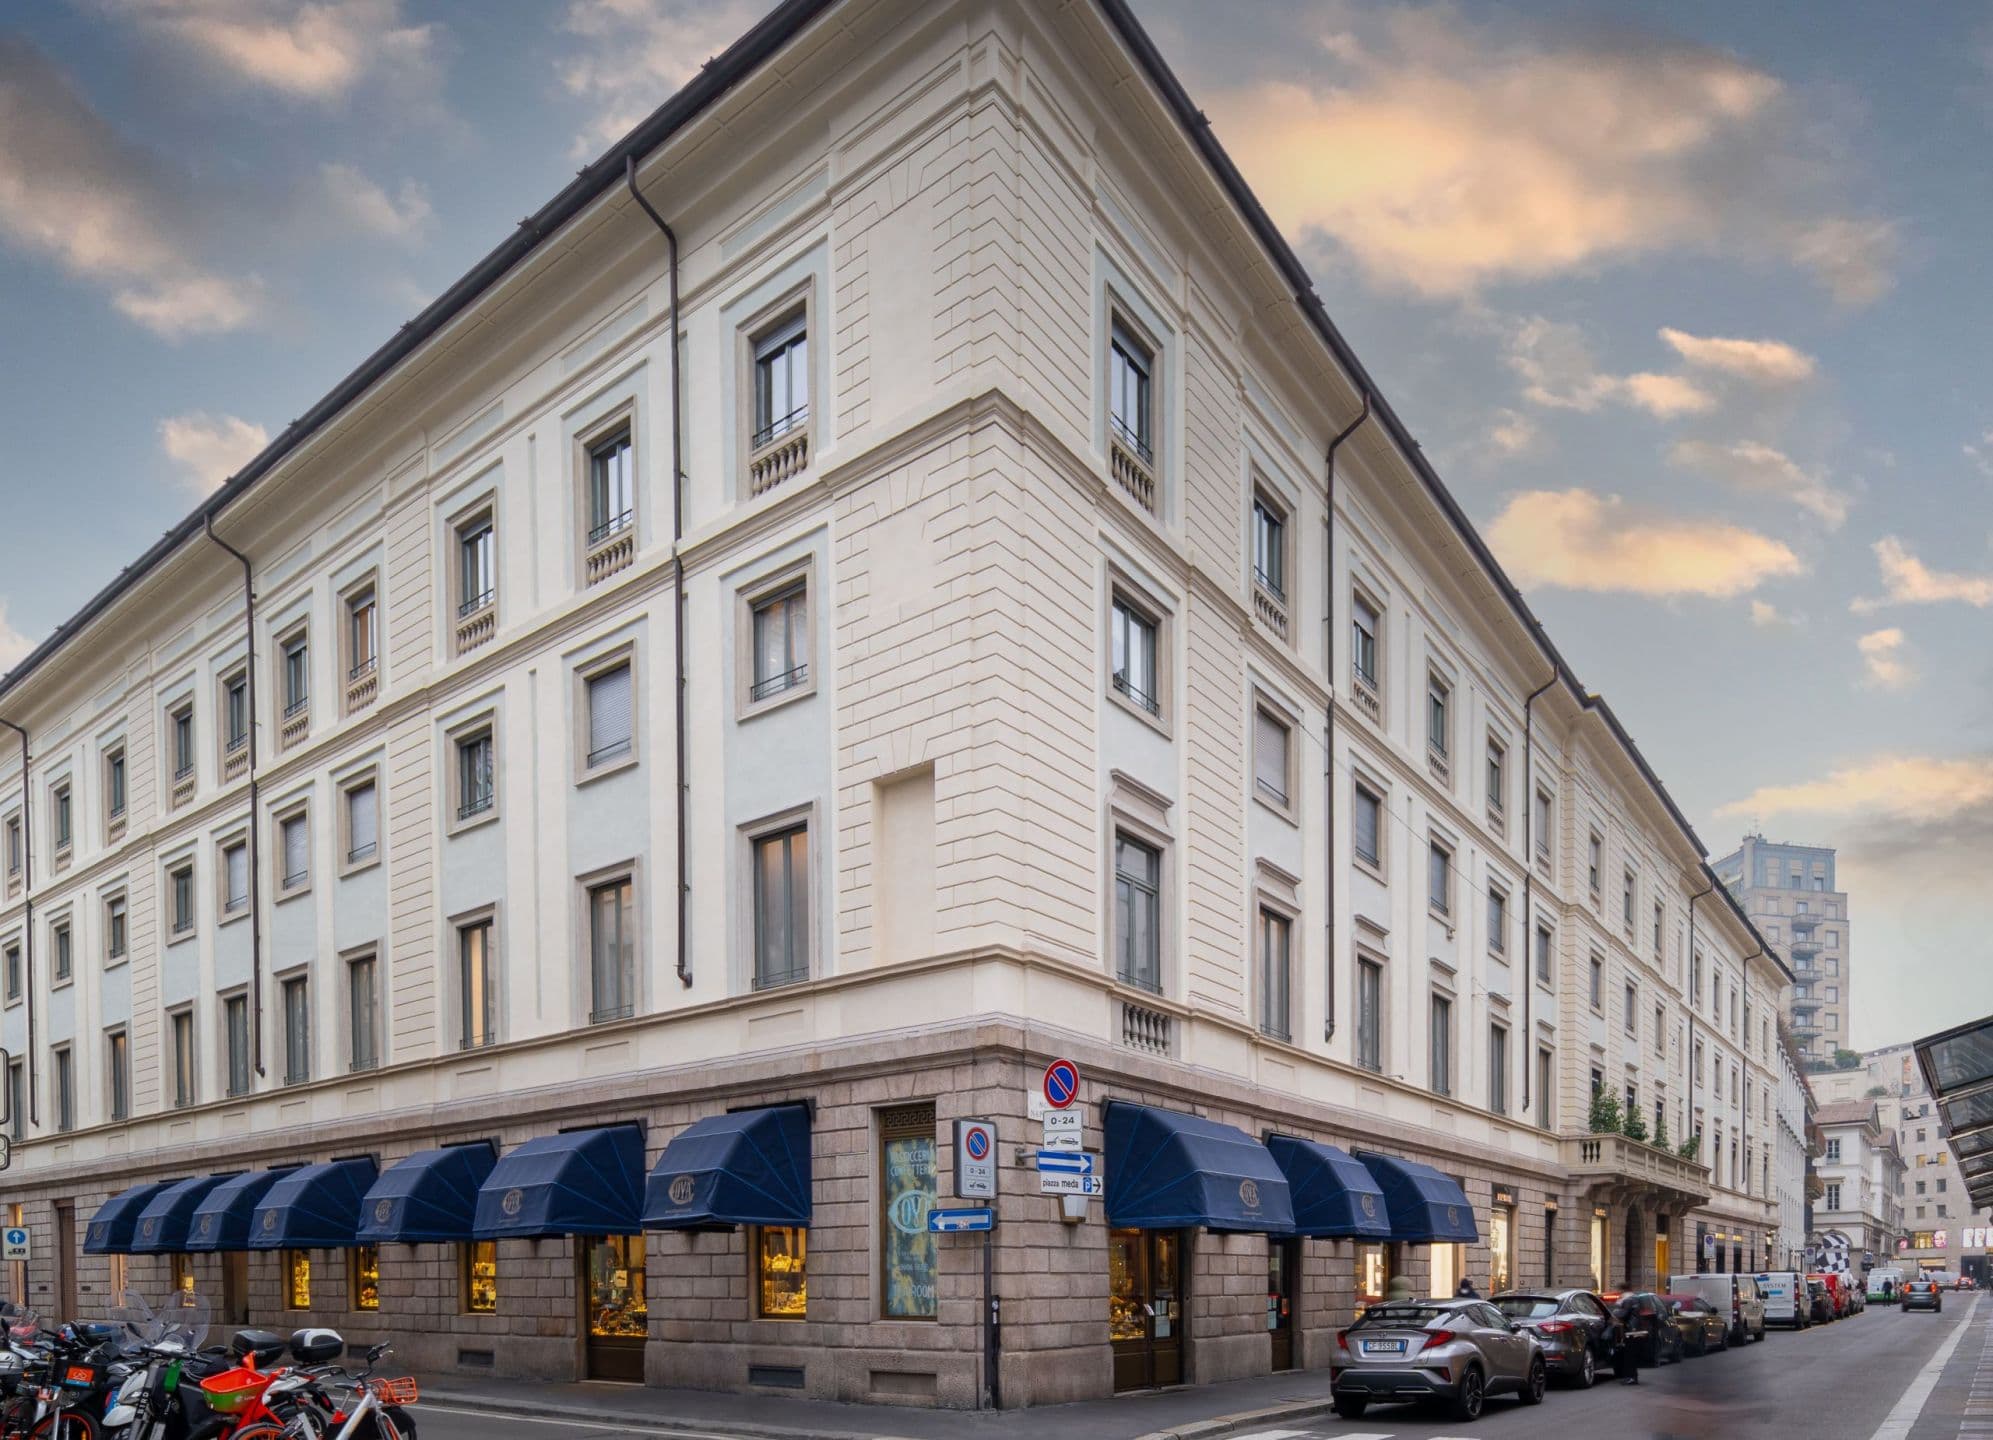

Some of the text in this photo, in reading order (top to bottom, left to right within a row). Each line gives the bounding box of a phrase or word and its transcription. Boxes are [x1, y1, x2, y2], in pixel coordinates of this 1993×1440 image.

[1050, 1116, 1075, 1125] 0-24
[1042, 1179, 1060, 1188] piazza
[1061, 1179, 1079, 1189] meda
